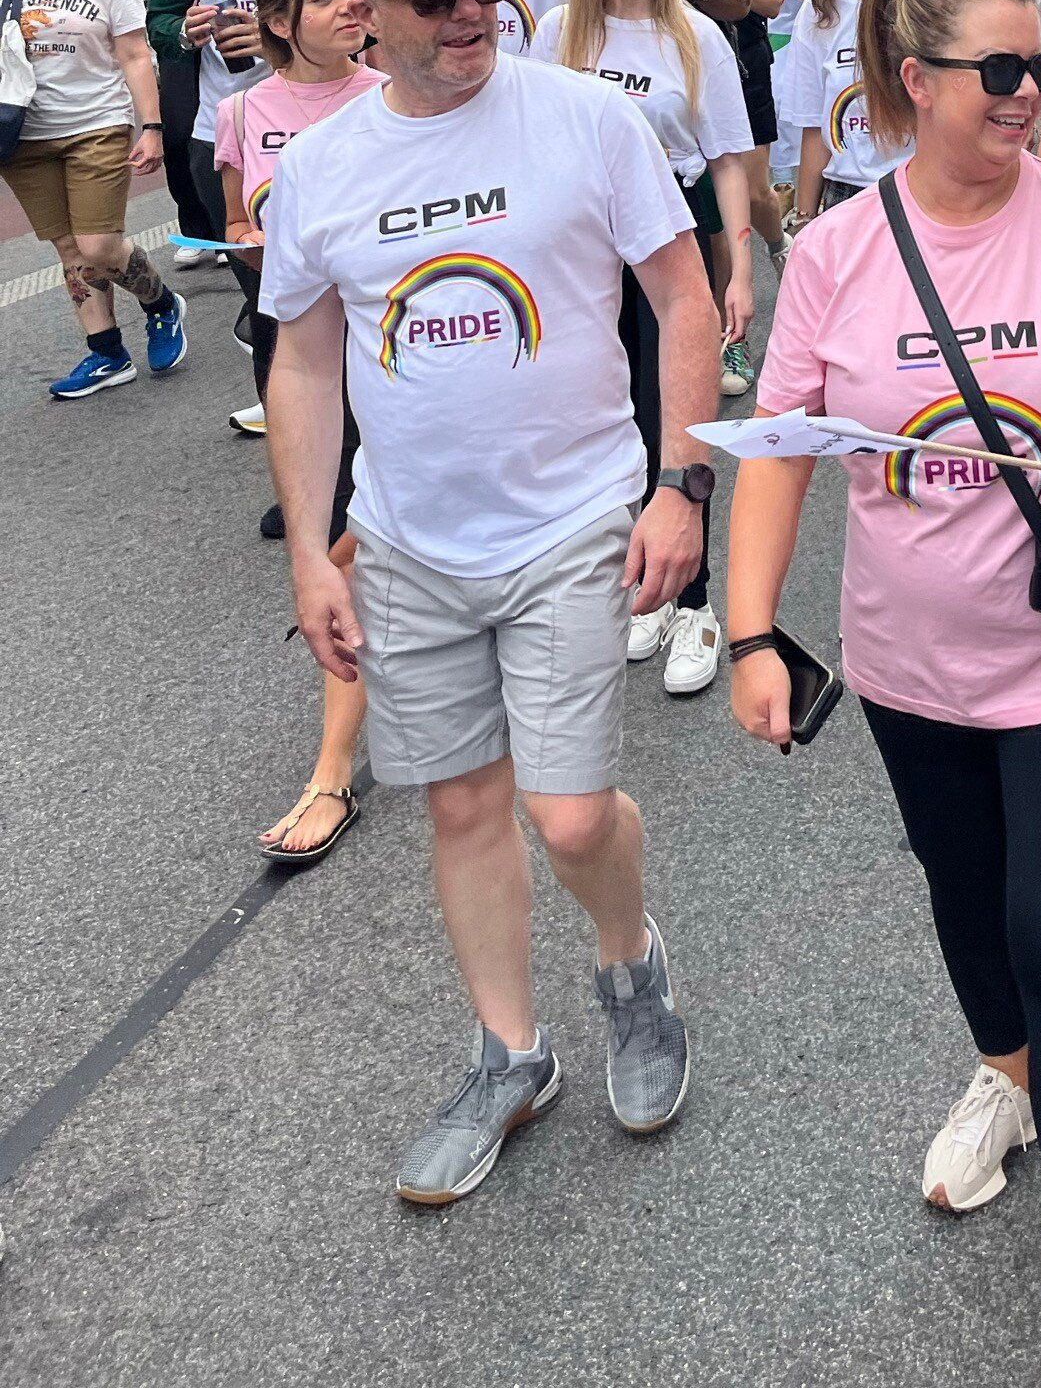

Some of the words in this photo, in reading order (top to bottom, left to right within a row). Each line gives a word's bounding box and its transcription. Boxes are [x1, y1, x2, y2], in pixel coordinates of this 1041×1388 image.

[33, 43, 50, 52] THE
[52, 43, 76, 54] ROAD
[582, 67, 652, 93] PM
[379, 187, 507, 236] CPM
[408, 309, 502, 344] PRIDE
[897, 321, 1038, 360] CPM
